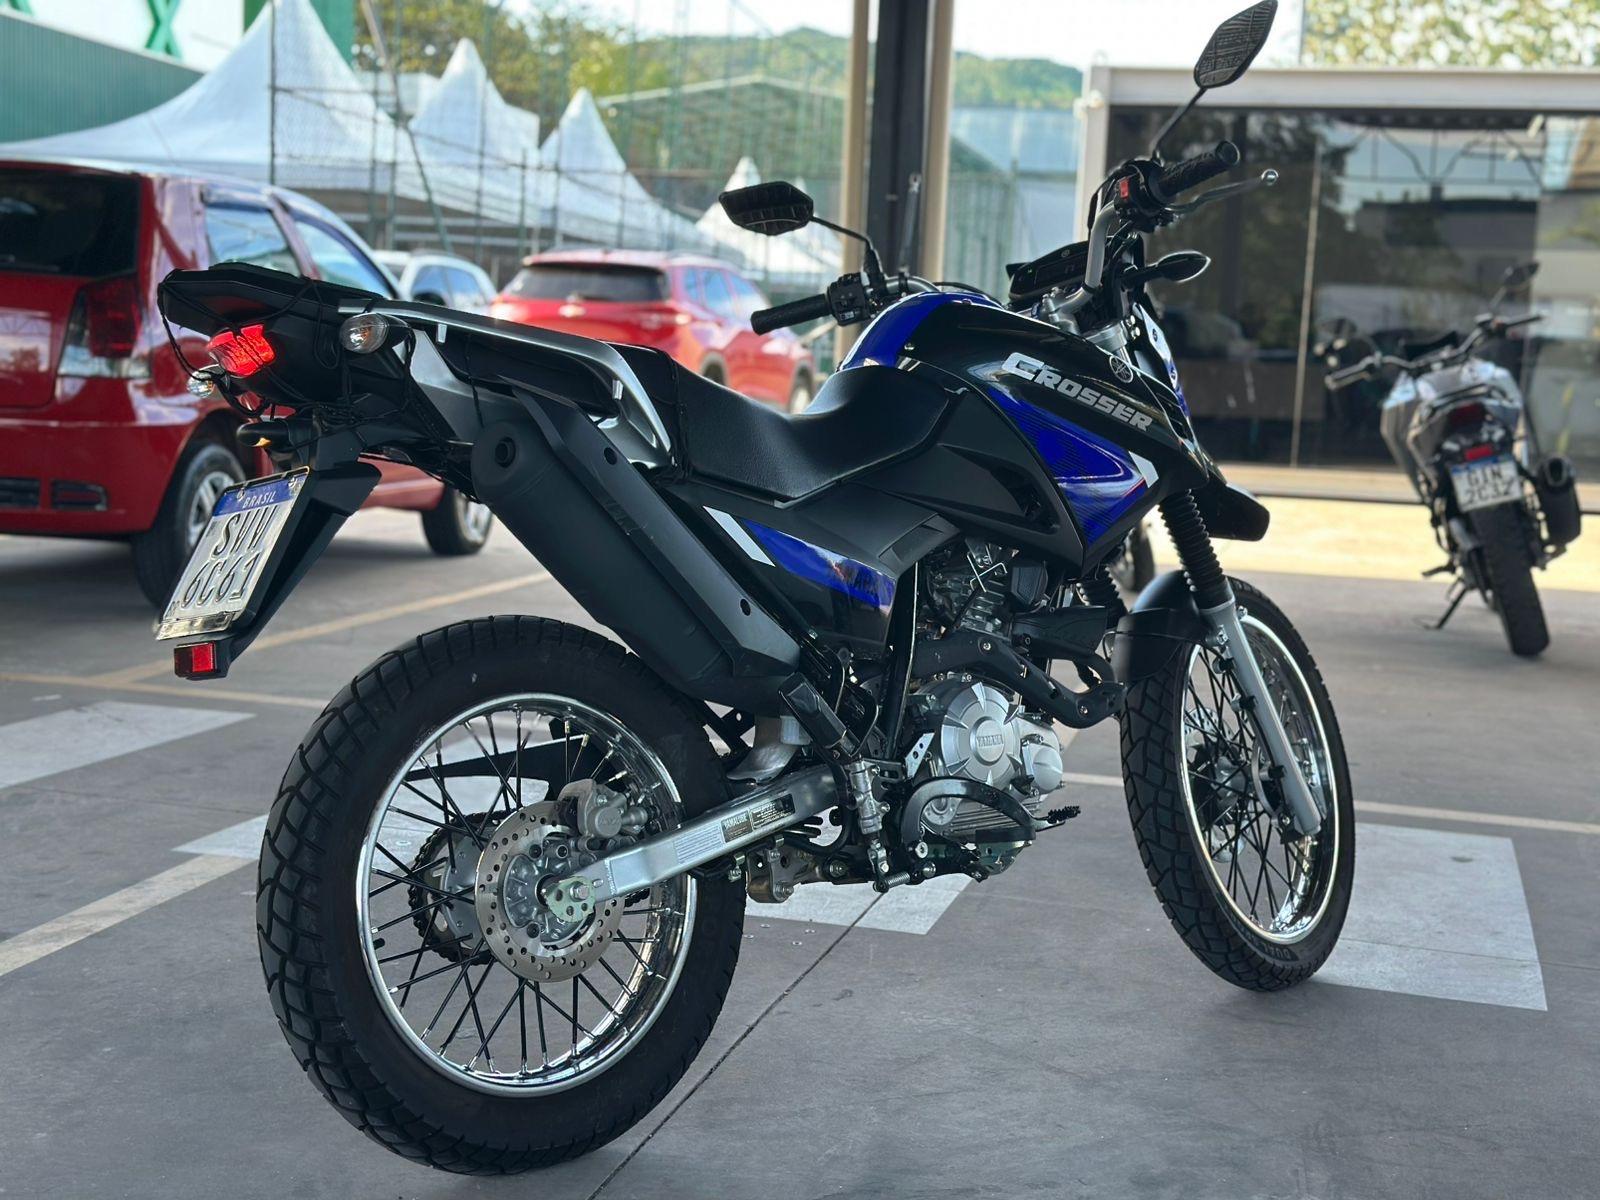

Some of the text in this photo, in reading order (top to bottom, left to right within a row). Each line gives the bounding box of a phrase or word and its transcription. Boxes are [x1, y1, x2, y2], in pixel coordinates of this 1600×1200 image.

[1001, 352, 1153, 432] CROSSER
[242, 490, 277, 509] BRASIL
[180, 552, 261, 609] 6C61
